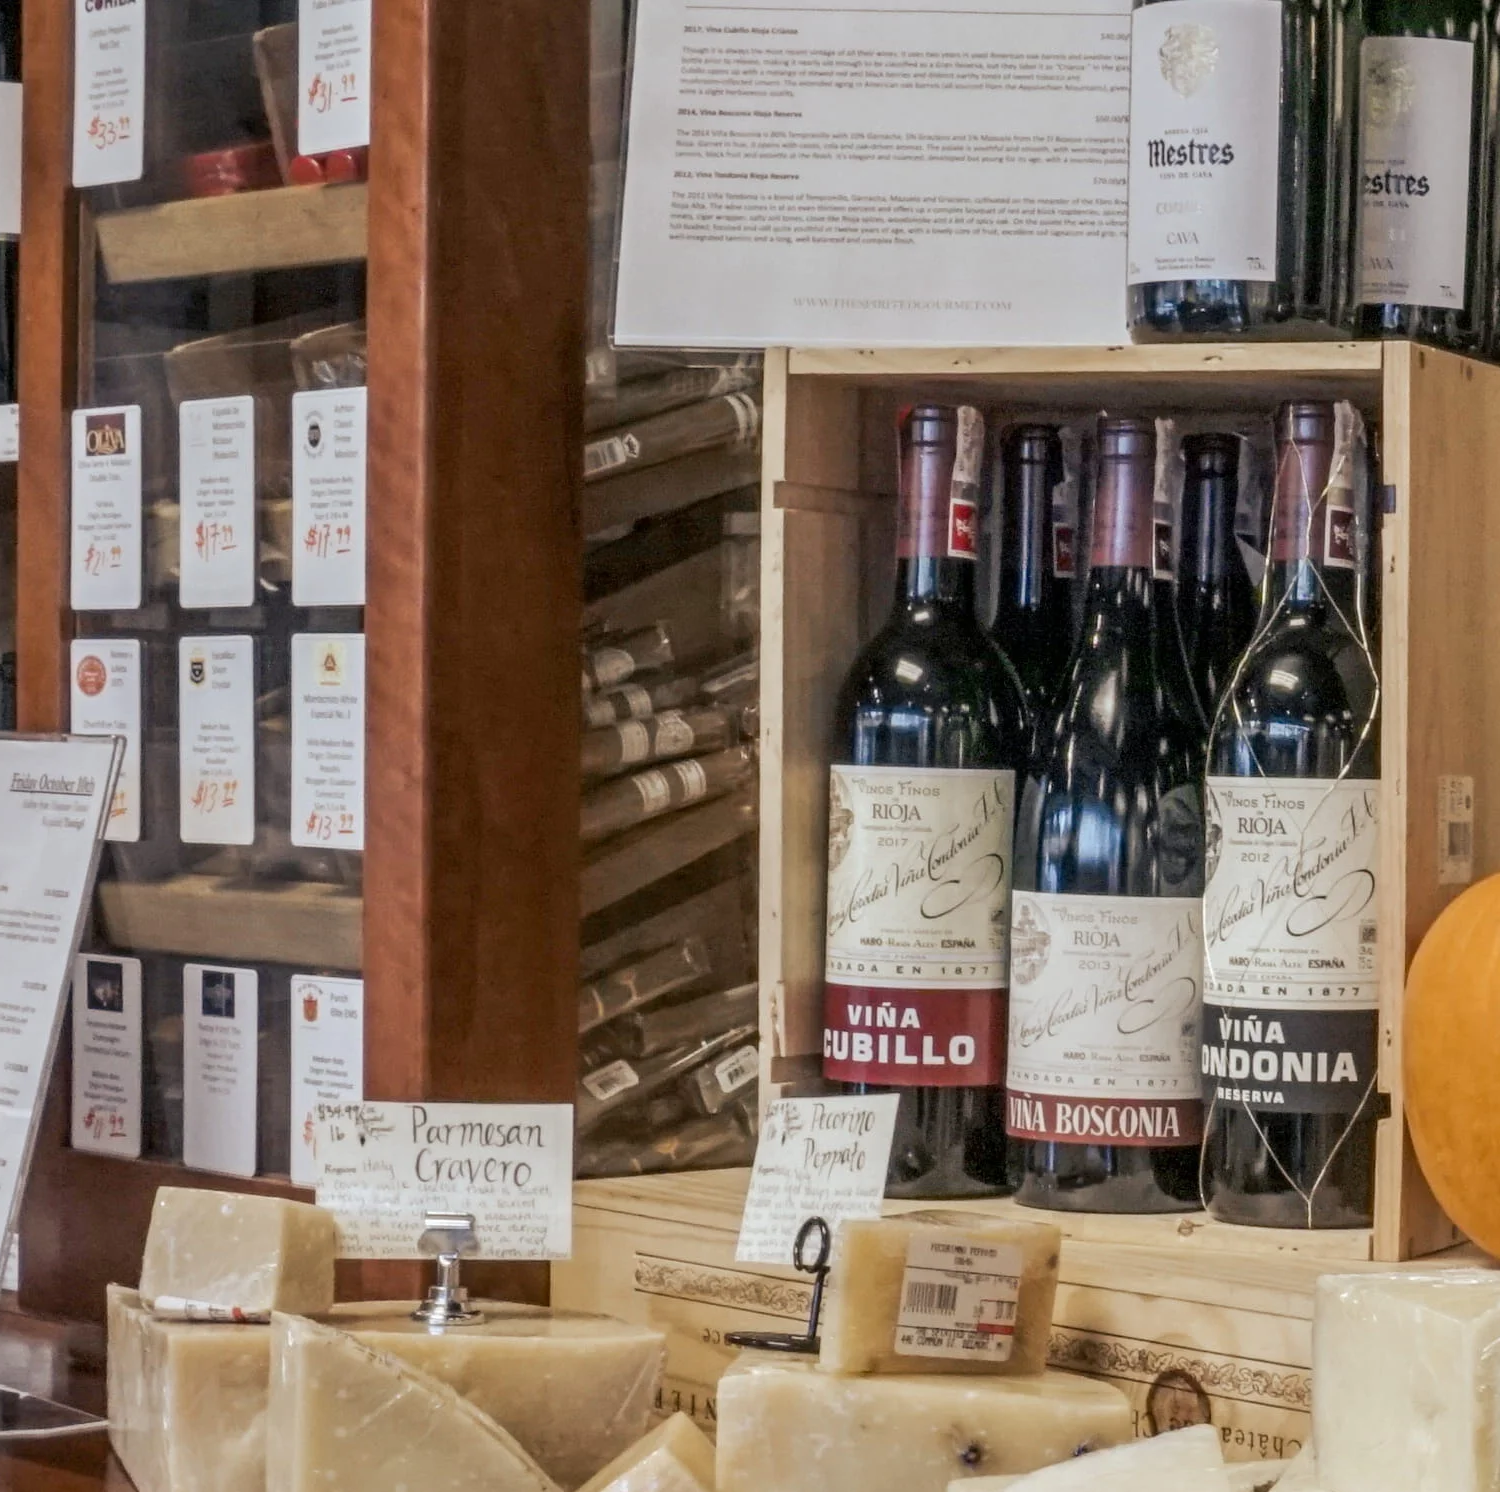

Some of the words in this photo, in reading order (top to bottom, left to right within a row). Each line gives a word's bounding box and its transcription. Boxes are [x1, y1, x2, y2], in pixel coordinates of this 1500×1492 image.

[308, 72, 358, 113] $31.99
[1148, 139, 1234, 168] Mestres
[1361, 169, 1430, 197] estres
[86, 424, 126, 456] OLIVA
[196, 520, 236, 562] $17.99
[304, 523, 351, 558] $17.99
[40, 774, 76, 792] October
[191, 780, 238, 815] $13.99
[306, 813, 354, 840] $13.99
[872, 803, 921, 822] RIOJA
[1238, 816, 1287, 837] RIOJA
[877, 837, 909, 847] 2017
[1241, 853, 1270, 863] 2012
[941, 936, 976, 949] ESPAÑA
[1074, 931, 1121, 949] RIOJA
[896, 966, 921, 975] EN
[941, 966, 989, 975] 1877
[1308, 958, 1345, 969] ESPAÑA
[1262, 985, 1288, 996] EN
[1308, 986, 1360, 996] 1877
[848, 1001, 921, 1029] VIÑA
[1218, 1015, 1285, 1044] VIÑA
[824, 1028, 975, 1066] CUBILLO
[1202, 1044, 1358, 1083] ONDONIA
[1093, 1078, 1116, 1087] EN
[1136, 1079, 1179, 1087] 1877
[1217, 1086, 1285, 1103] RESERVA
[405, 1105, 545, 1148] Parmesan
[811, 1103, 875, 1136] Pecorino
[1009, 1093, 1046, 1132] VIÑA
[1055, 1102, 1180, 1138] BOSCONIA
[414, 1148, 532, 1187] Cravero
[804, 1138, 866, 1181] Peppato
[1221, 1427, 1302, 1458] Châtea
